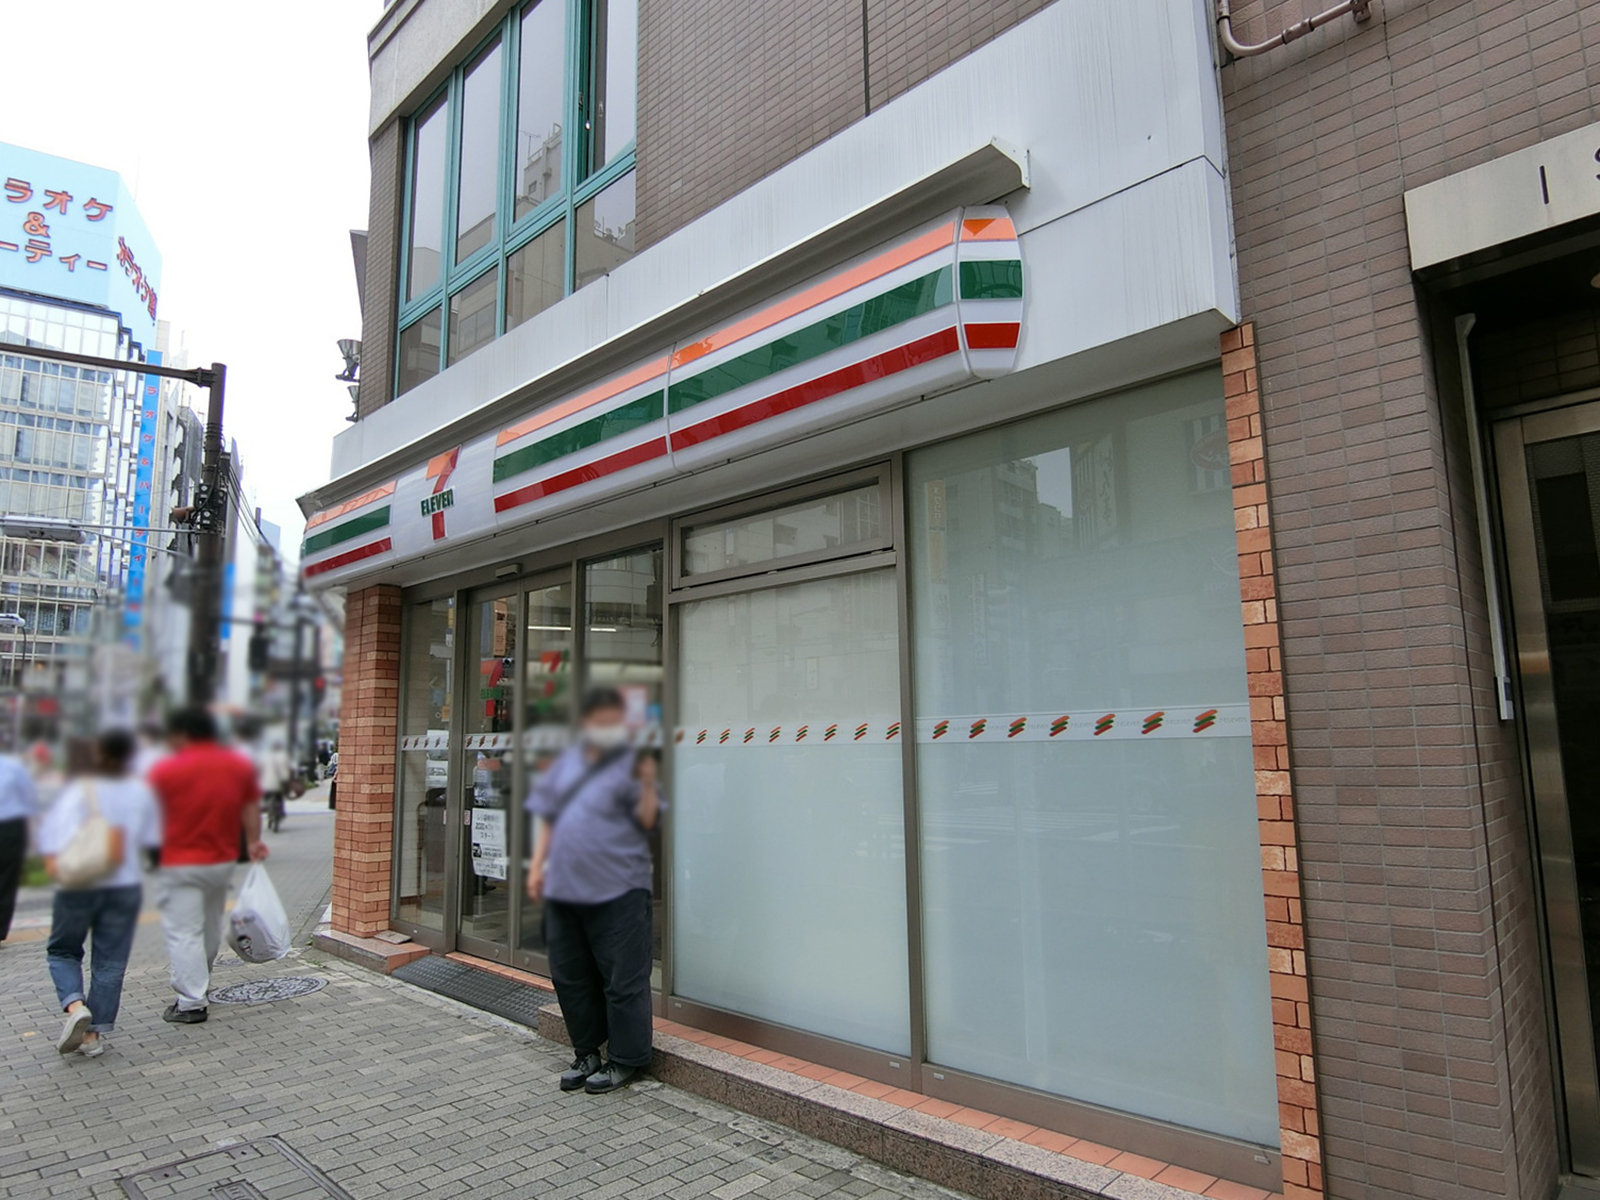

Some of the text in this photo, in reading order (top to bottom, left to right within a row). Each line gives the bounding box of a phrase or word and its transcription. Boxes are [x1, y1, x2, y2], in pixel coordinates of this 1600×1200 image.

[4, 177, 113, 222] ラオケ
[23, 211, 51, 238] &
[426, 445, 460, 541] 7
